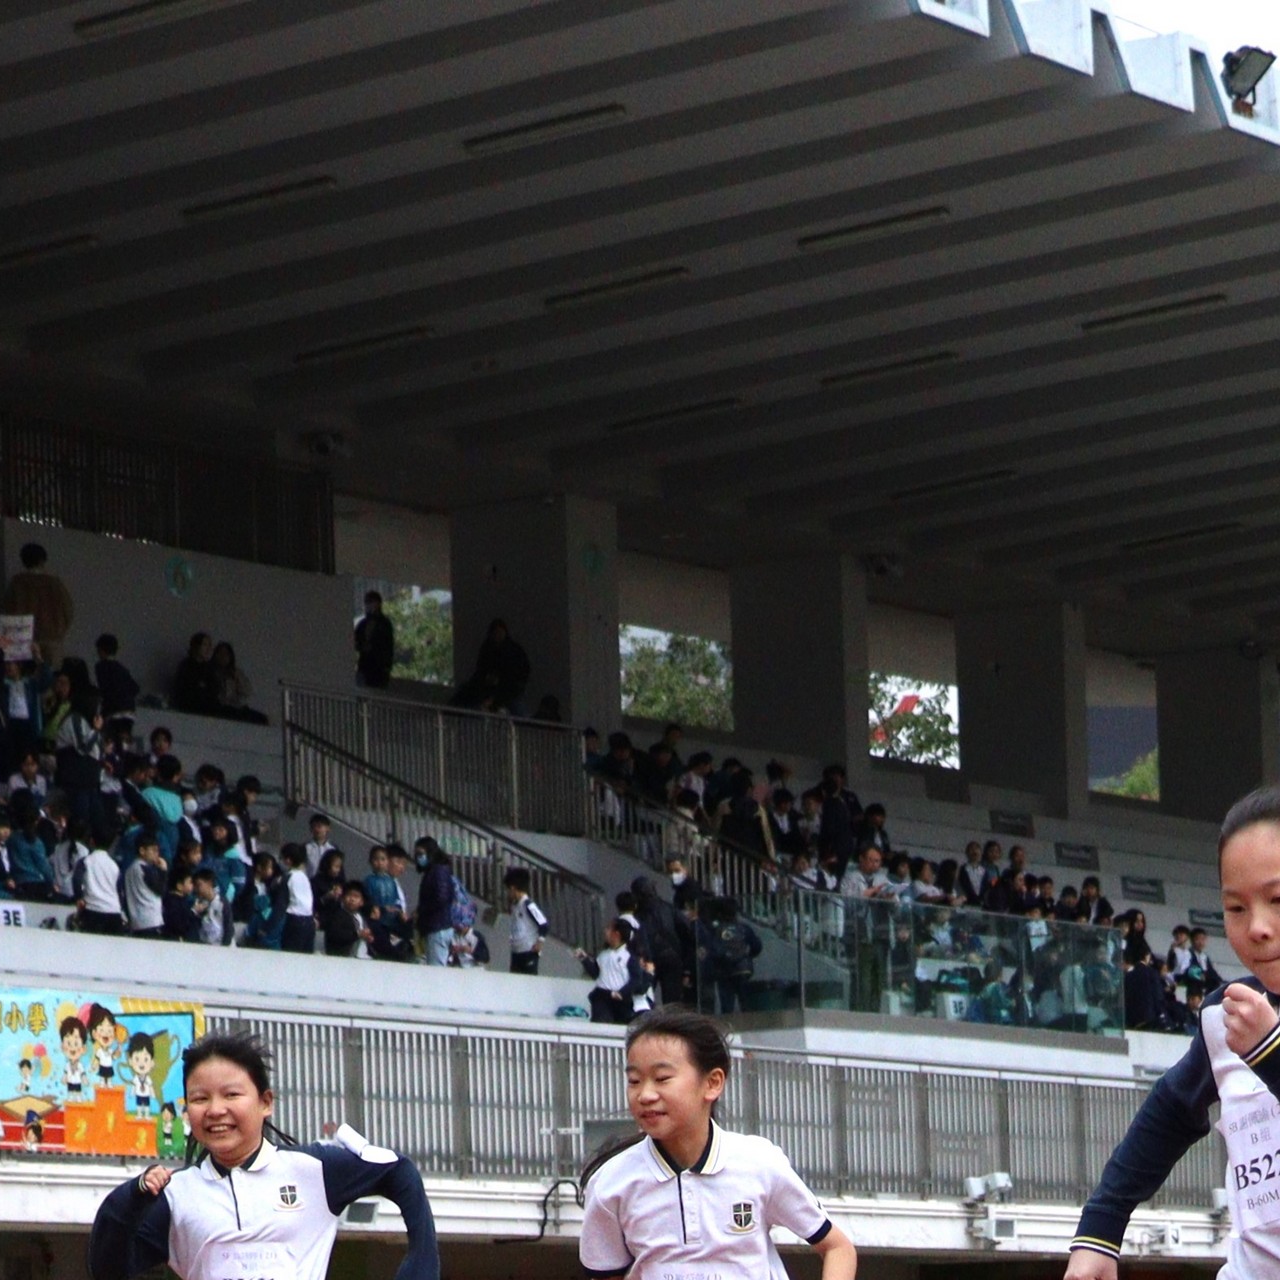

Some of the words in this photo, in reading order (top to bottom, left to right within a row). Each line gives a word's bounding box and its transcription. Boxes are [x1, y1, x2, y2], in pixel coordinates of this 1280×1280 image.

[2, 909, 22, 927] 3E
[73, 1117, 88, 1141] 2
[135, 1126, 148, 1151] 3
